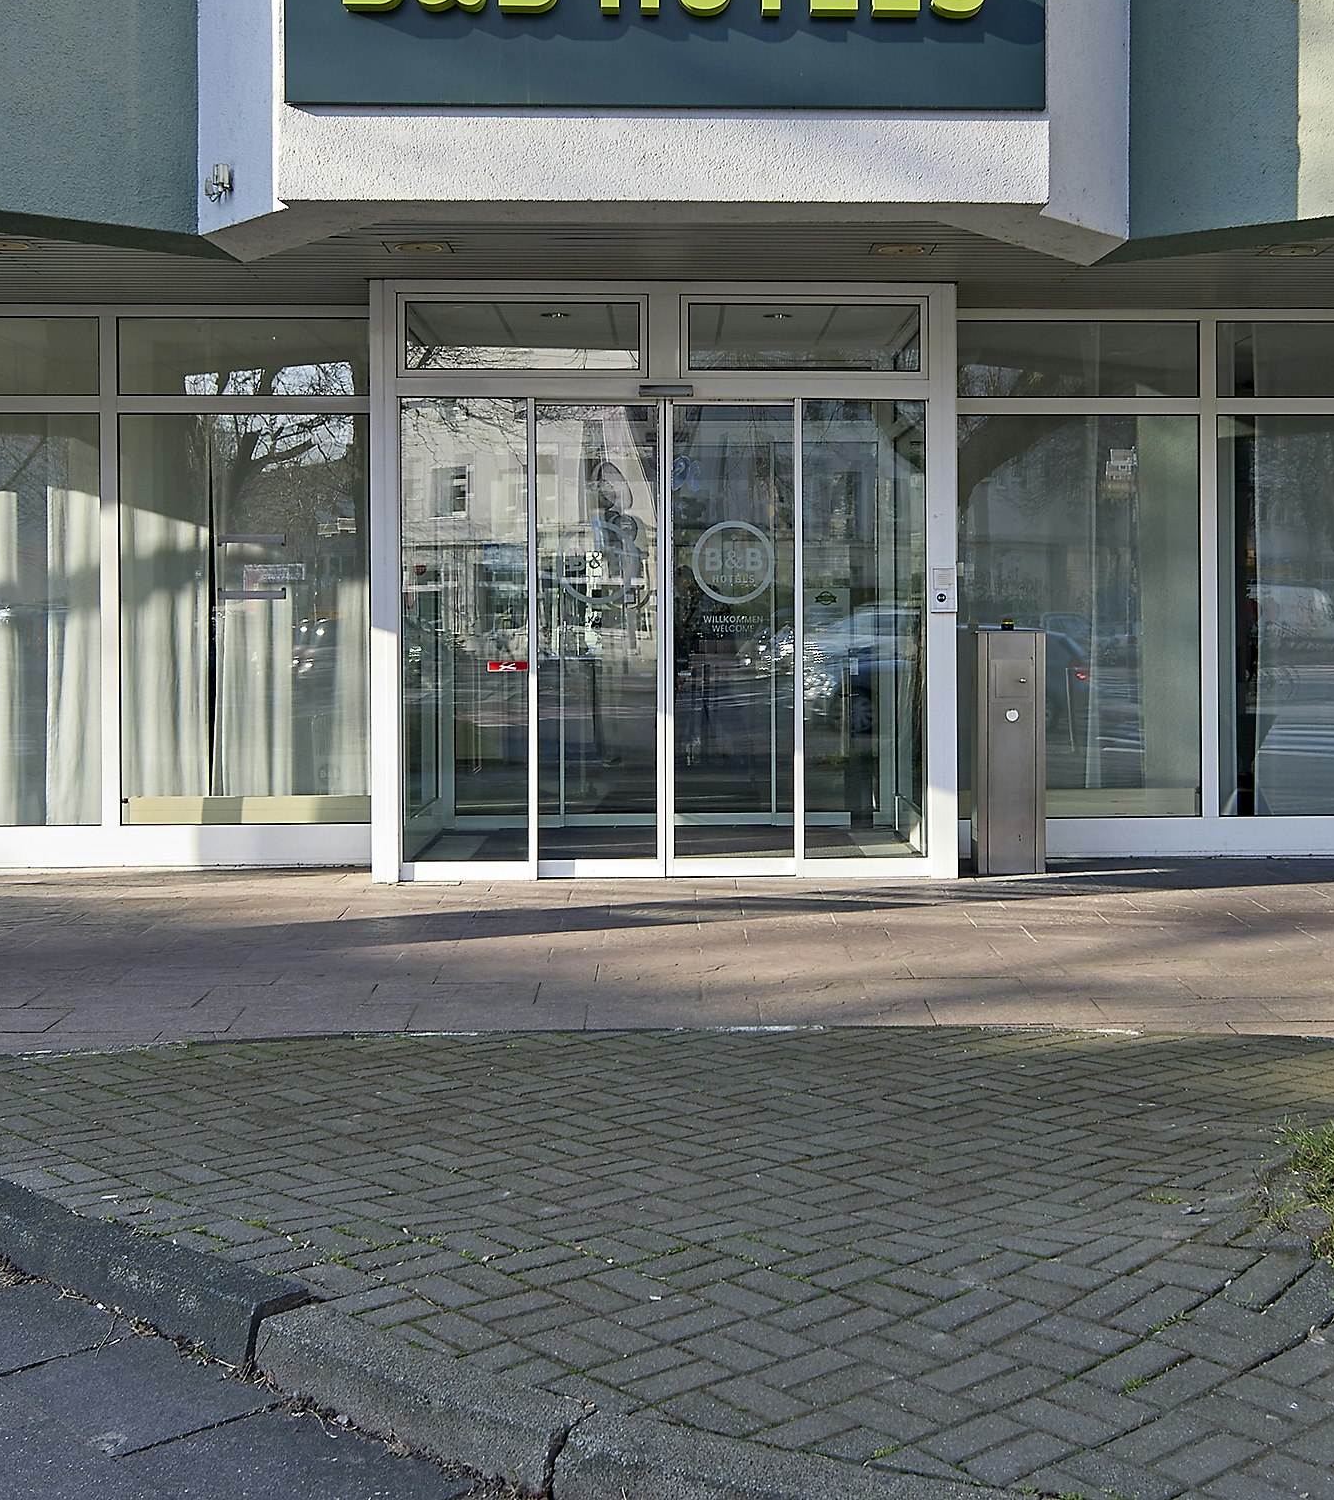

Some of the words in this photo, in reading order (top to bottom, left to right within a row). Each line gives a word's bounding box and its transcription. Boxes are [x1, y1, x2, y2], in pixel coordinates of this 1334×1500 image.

[705, 547, 764, 572] B&B
[712, 574, 755, 584] HOTELS
[702, 615, 764, 624] WILLKOMMEN
[711, 624, 755, 633] WELCOME
